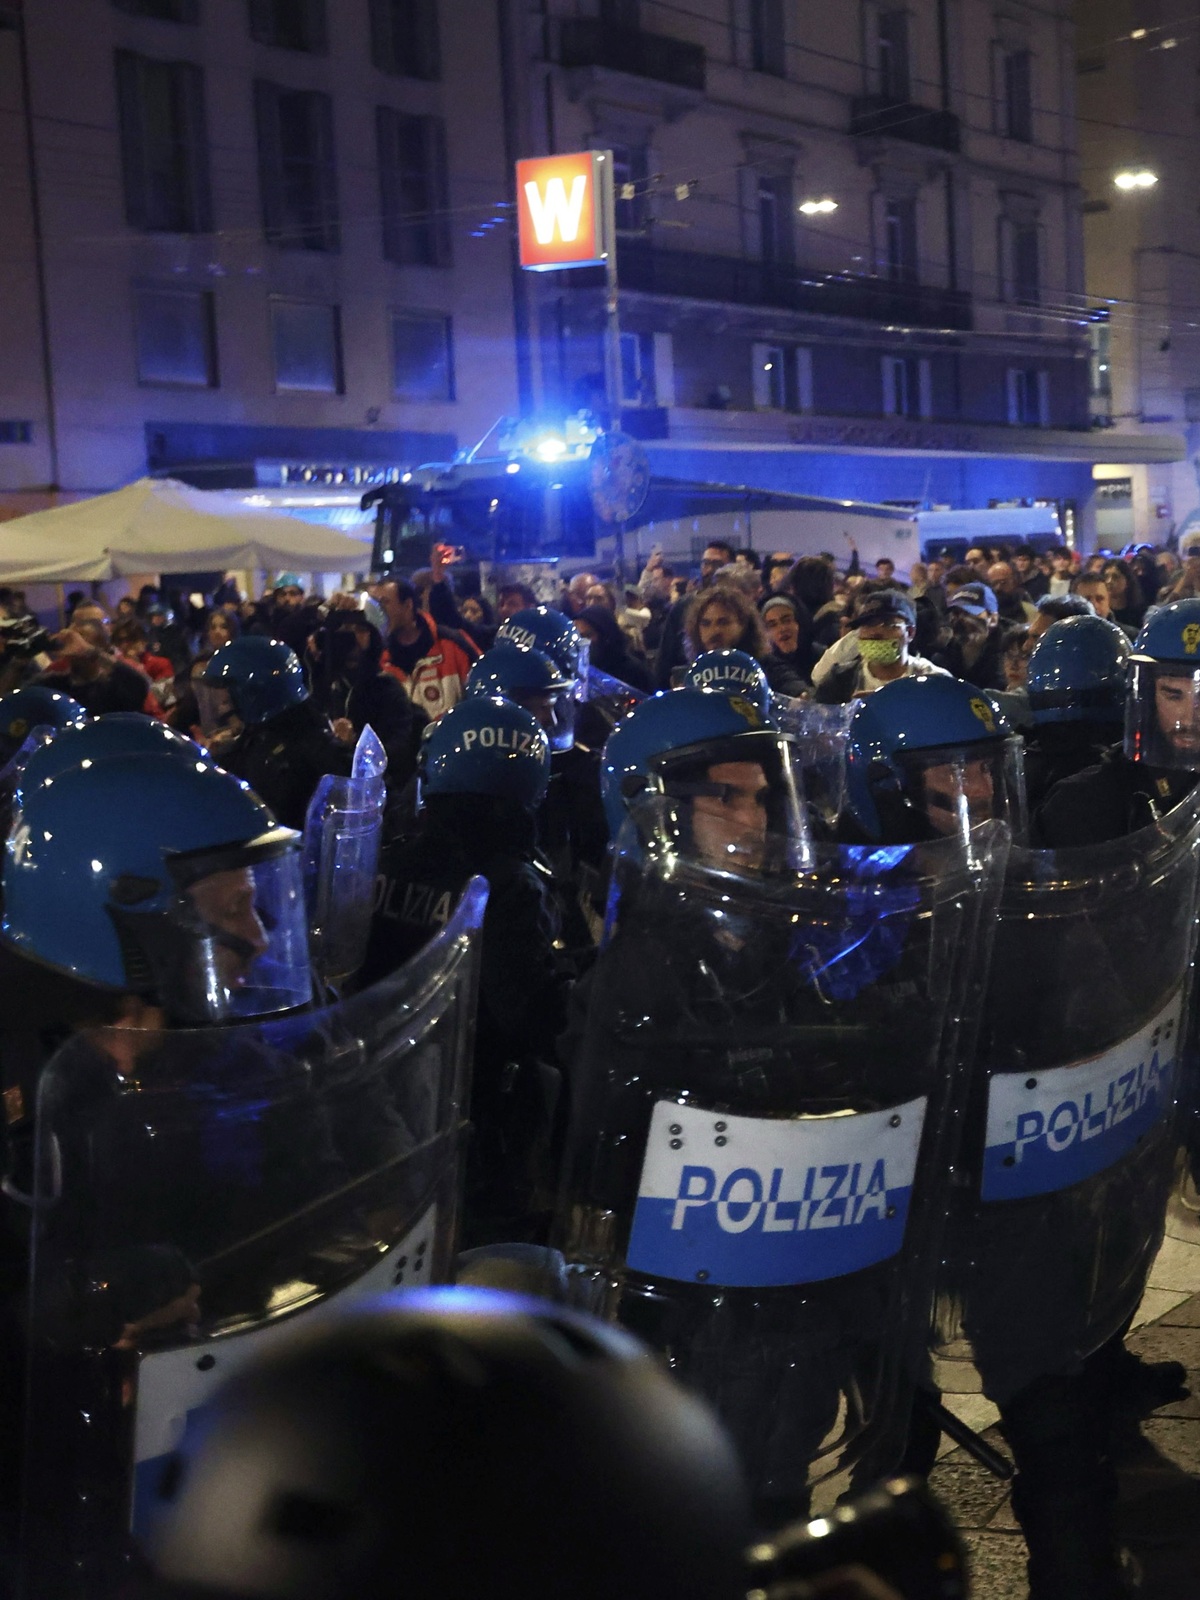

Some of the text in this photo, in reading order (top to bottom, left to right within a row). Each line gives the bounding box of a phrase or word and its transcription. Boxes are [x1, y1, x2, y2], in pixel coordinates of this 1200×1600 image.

[692, 665, 759, 687] POLIZIA
[374, 873, 452, 927] OLIZIA
[1015, 1050, 1161, 1164] POLIZIA
[671, 1158, 887, 1234] POLIZIA
